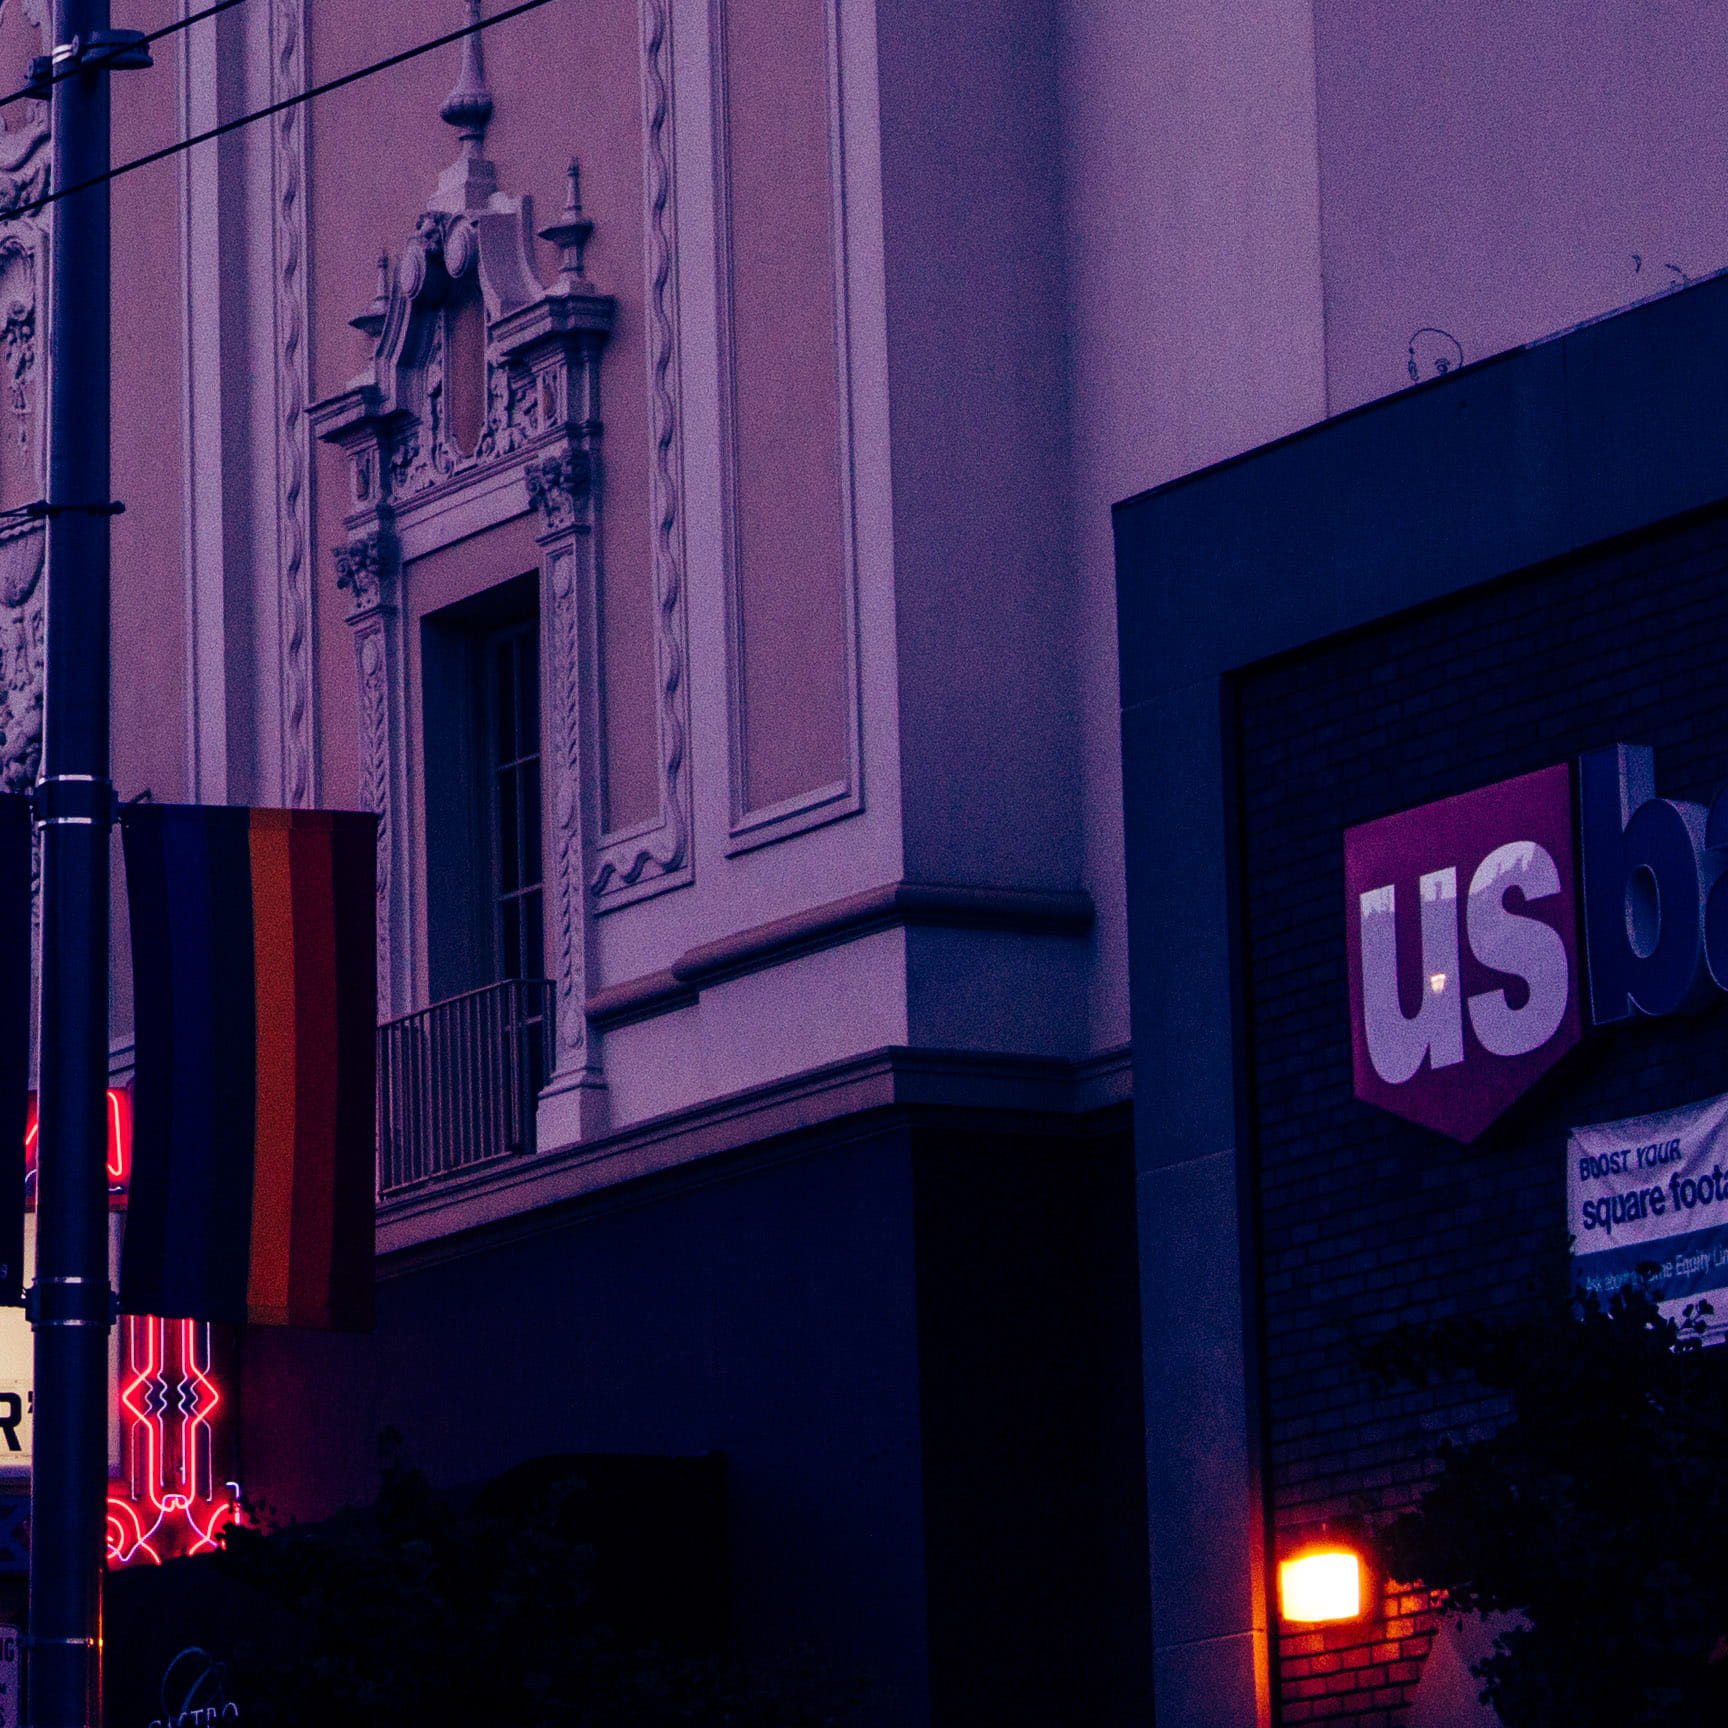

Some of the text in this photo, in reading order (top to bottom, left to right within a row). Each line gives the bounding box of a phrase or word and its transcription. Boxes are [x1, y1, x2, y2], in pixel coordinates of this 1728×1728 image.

[1359, 839, 1570, 1085] us
[1578, 1138, 1682, 1181] BOOST YOUR
[1582, 1185, 1666, 1235] square
[1675, 1248, 1712, 1279] Equity
